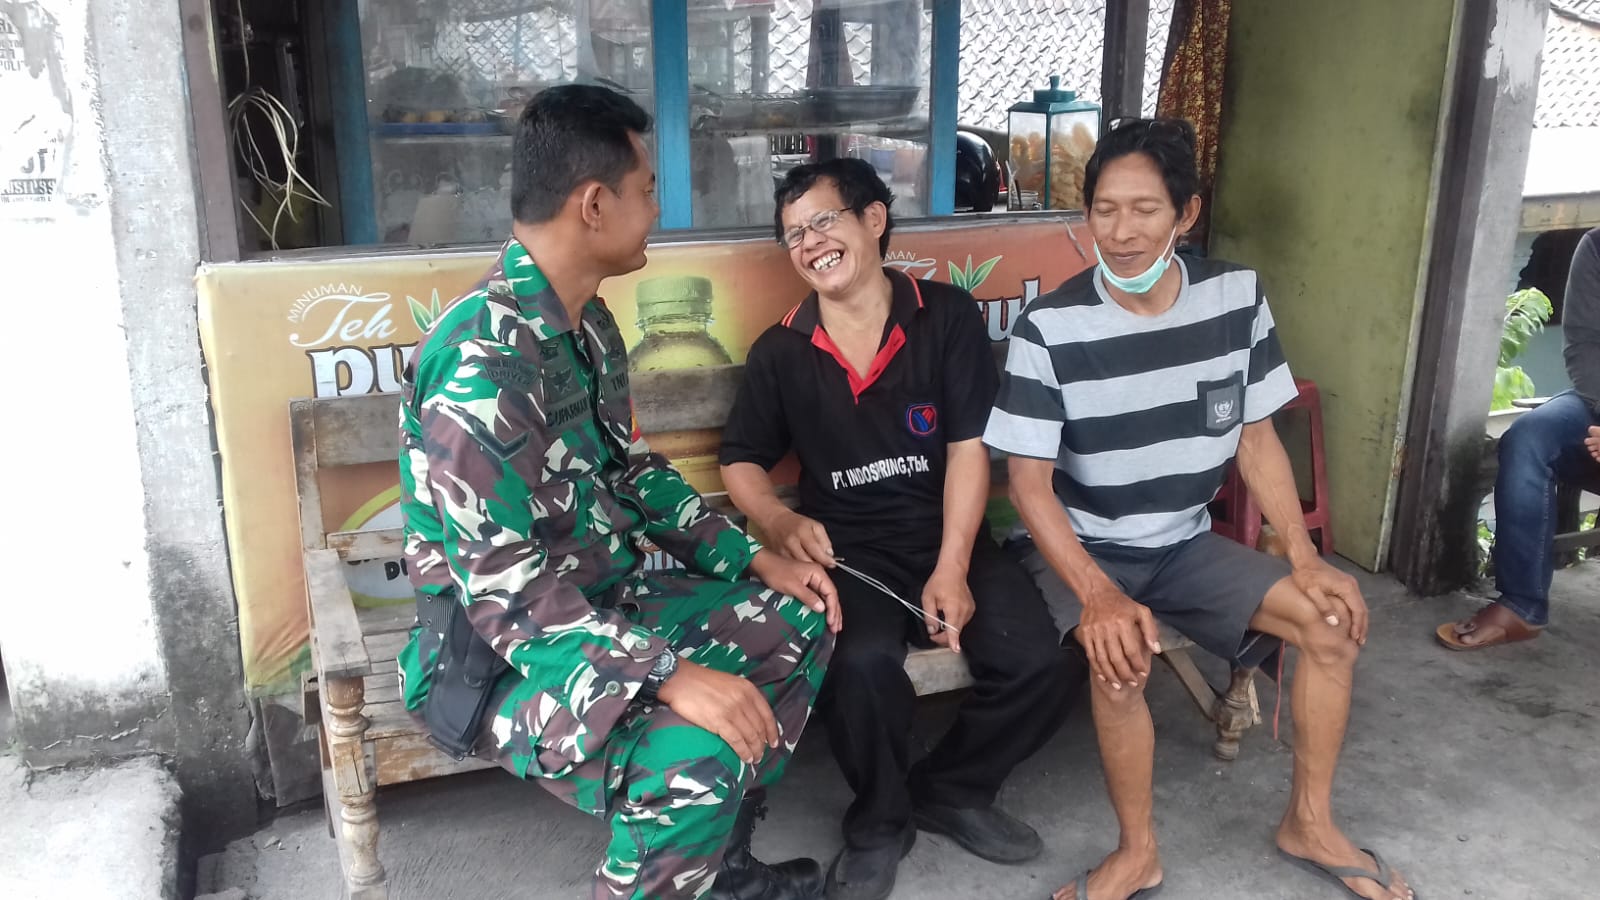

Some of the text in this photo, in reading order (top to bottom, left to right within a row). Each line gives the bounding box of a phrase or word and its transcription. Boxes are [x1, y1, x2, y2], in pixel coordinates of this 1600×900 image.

[287, 282, 362, 324] MINUMAN
[289, 292, 397, 347] Teh
[831, 471, 848, 490] PT.
